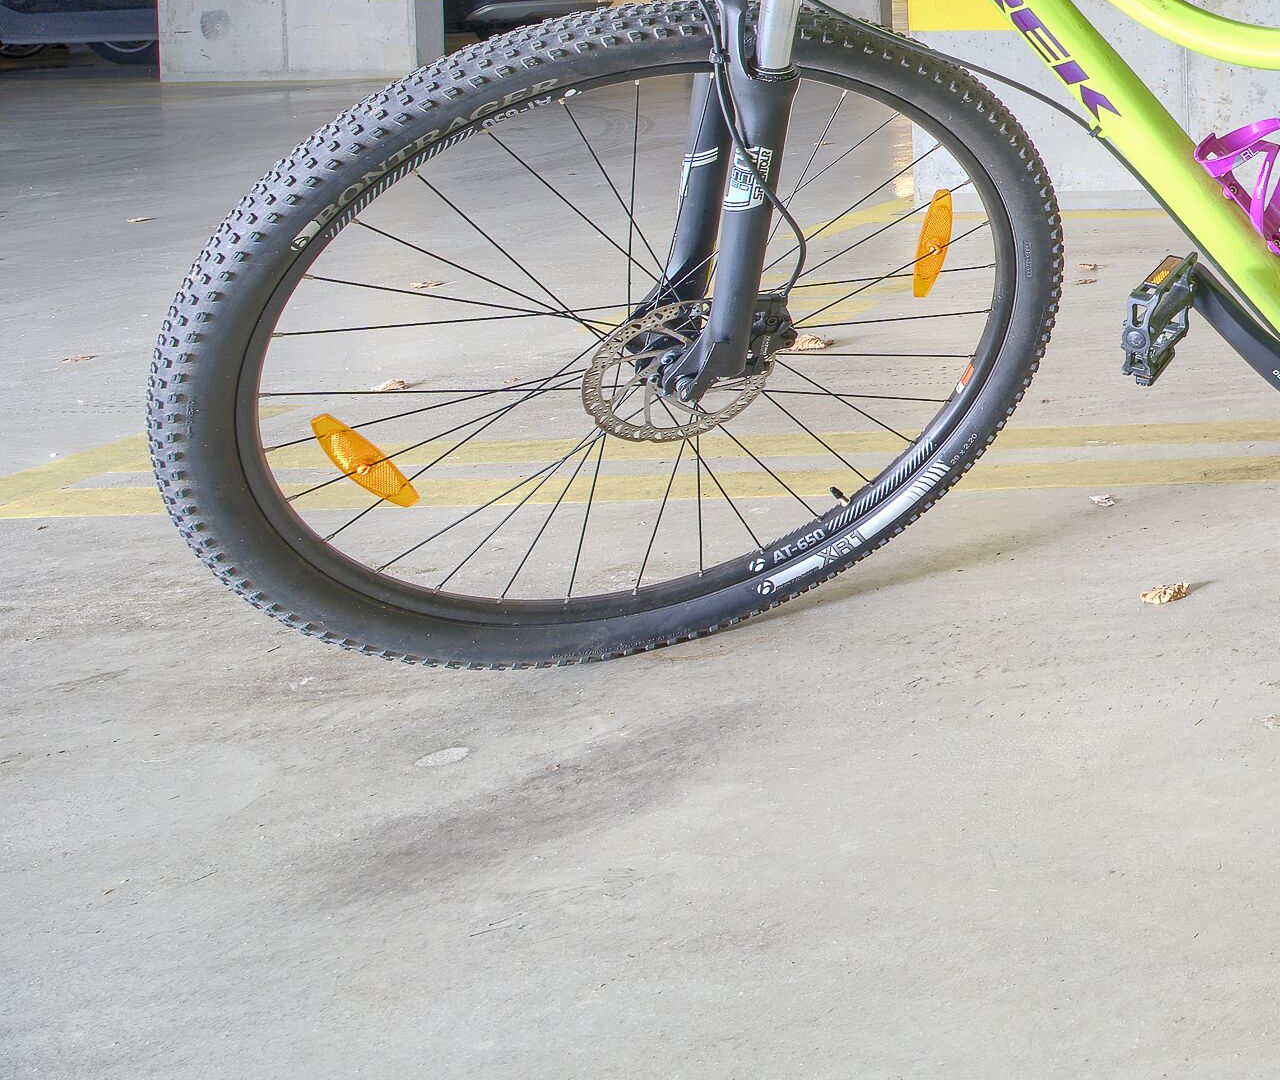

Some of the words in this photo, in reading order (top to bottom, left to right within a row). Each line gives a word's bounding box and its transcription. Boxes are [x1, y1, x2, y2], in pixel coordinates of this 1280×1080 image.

[317, 78, 559, 225] BONTRAGER
[773, 528, 826, 565] AT-650
[817, 529, 867, 566] XR1
